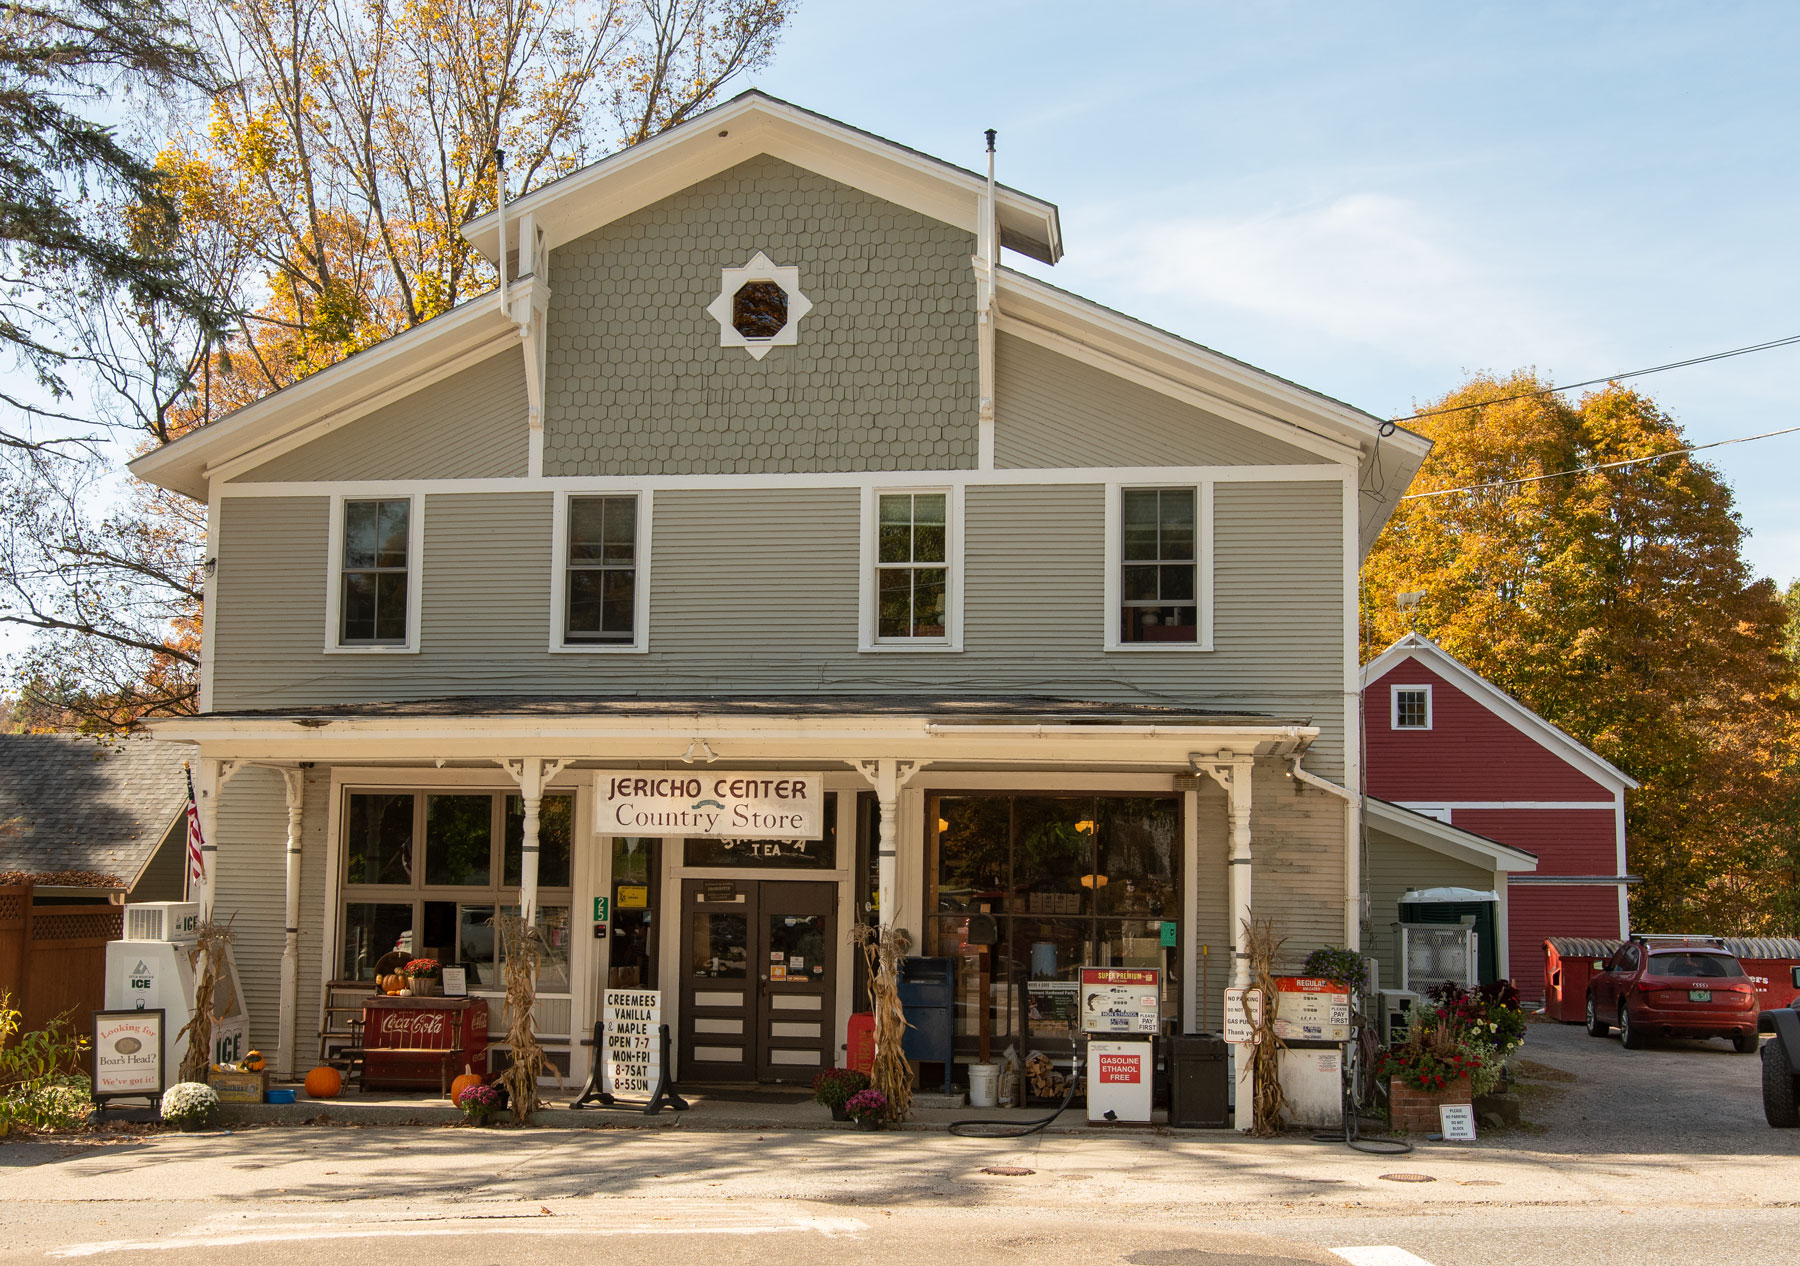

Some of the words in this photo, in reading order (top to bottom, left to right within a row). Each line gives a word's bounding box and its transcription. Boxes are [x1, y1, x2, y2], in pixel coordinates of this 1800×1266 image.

[608, 778, 702, 800] JERICHO
[714, 780, 807, 799] CENTER
[616, 803, 720, 832] Country
[732, 804, 803, 829] Store
[752, 844, 780, 856] TEA
[184, 914, 198, 932] ICE
[132, 979, 150, 988] ICE
[608, 994, 656, 1007] CREEMEES
[615, 1008, 651, 1021] VANILLA
[100, 1024, 140, 1039] Looking
[142, 1026, 156, 1037] for
[608, 1022, 613, 1031] &
[617, 1024, 647, 1034] MAPLE
[216, 1030, 242, 1065] ICE
[609, 1036, 631, 1048] OPEN
[635, 1038, 650, 1048] 7-7
[100, 1055, 125, 1065] Boar's
[127, 1053, 156, 1064] Head?
[612, 1050, 650, 1063] MON-FRI
[129, 1078, 142, 1086] got
